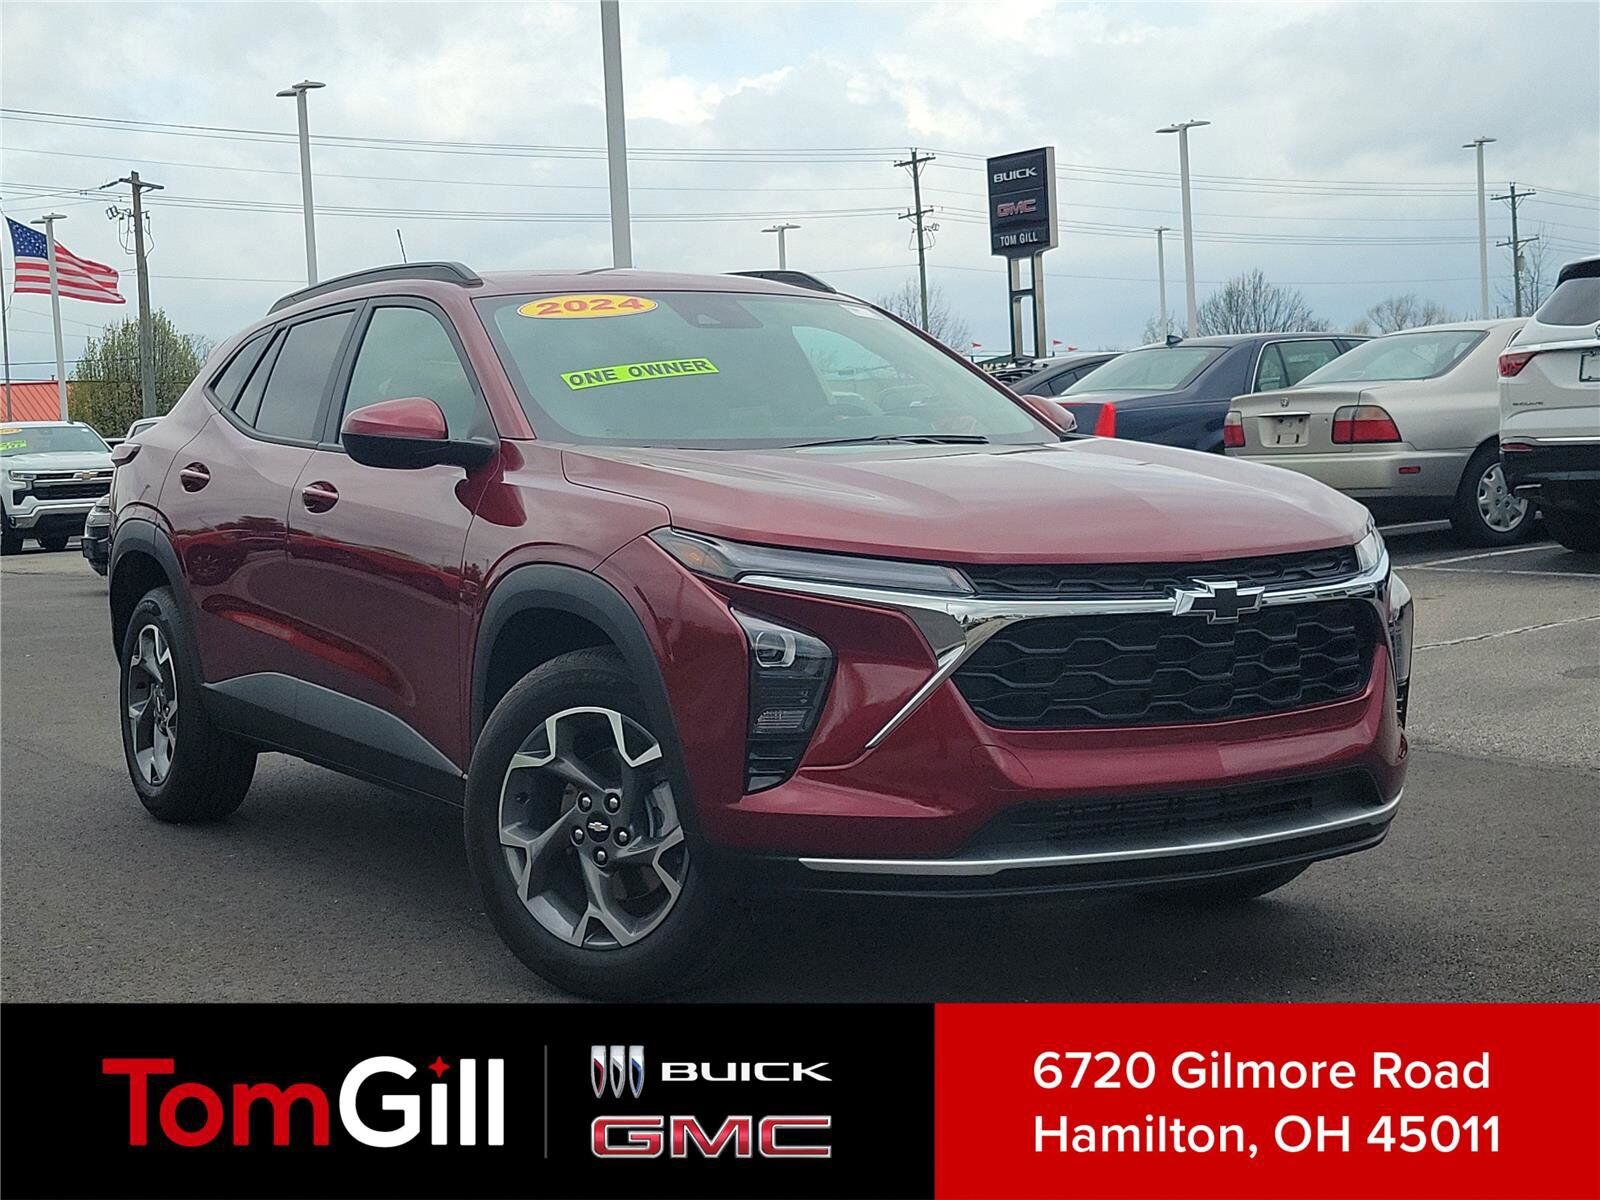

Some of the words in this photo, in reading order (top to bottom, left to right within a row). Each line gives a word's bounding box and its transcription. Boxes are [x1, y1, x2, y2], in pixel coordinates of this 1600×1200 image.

[994, 167, 1037, 183] BUICK
[997, 199, 1036, 217] GMC
[1000, 235, 1017, 247] TOM
[1020, 232, 1038, 244] GILL
[536, 298, 645, 315] 2024
[569, 368, 618, 386] ONE
[628, 359, 715, 378] OWNER
